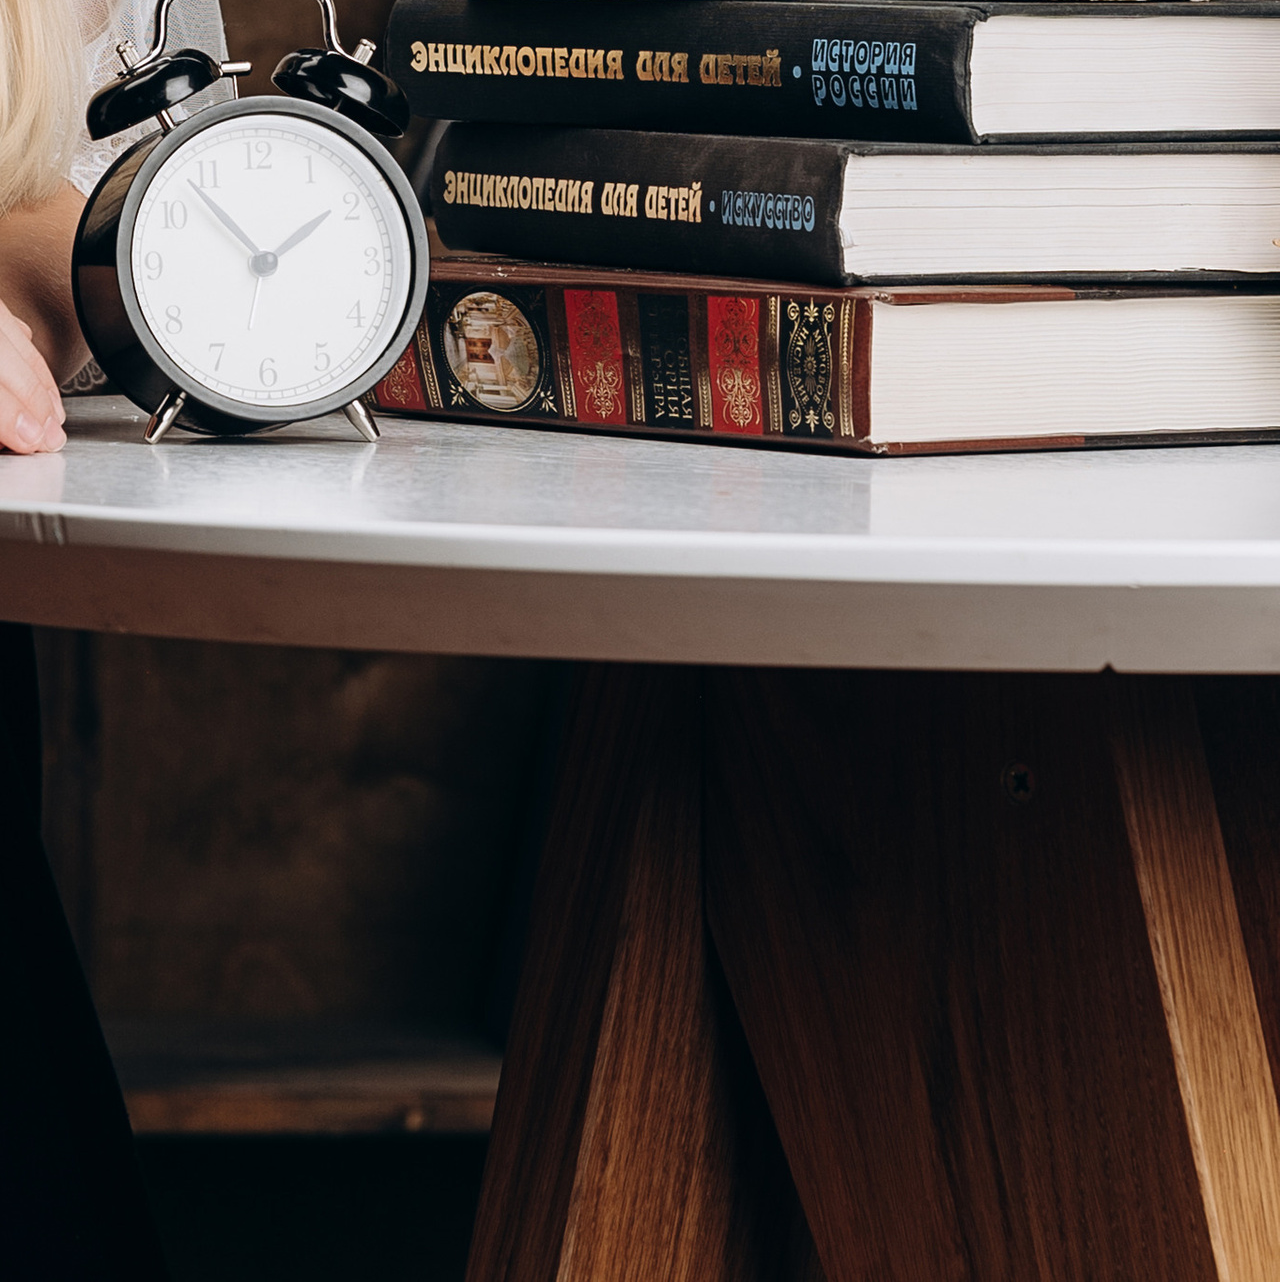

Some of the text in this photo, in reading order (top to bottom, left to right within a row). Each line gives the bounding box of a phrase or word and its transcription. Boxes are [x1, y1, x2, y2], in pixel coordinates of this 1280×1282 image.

[409, 40, 782, 88] ЭНЦИКЛОПЕДИЯ ДЛЯ ДЕТЕЙ
[811, 38, 917, 76] ИСТОРИЯ
[811, 74, 918, 111] РОССИИ
[243, 141, 273, 170] 12
[305, 155, 317, 184] 1
[195, 160, 221, 189] 11
[160, 200, 188, 230] 10
[342, 192, 361, 221] 2
[442, 169, 816, 233] ЭНЦИКЛОПЕДИЯ ДЛЯ ДЕТЕЙ ИСКУССТВО
[144, 251, 164, 280] 9
[364, 247, 380, 276] 3
[165, 305, 184, 335] 8
[346, 300, 367, 329] 4
[208, 343, 226, 372] 7
[314, 342, 331, 372] 5
[792, 326, 810, 406] НАСЛЕДИЕ
[812, 328, 828, 405] МИРОВОЕ
[258, 358, 278, 387] 6
